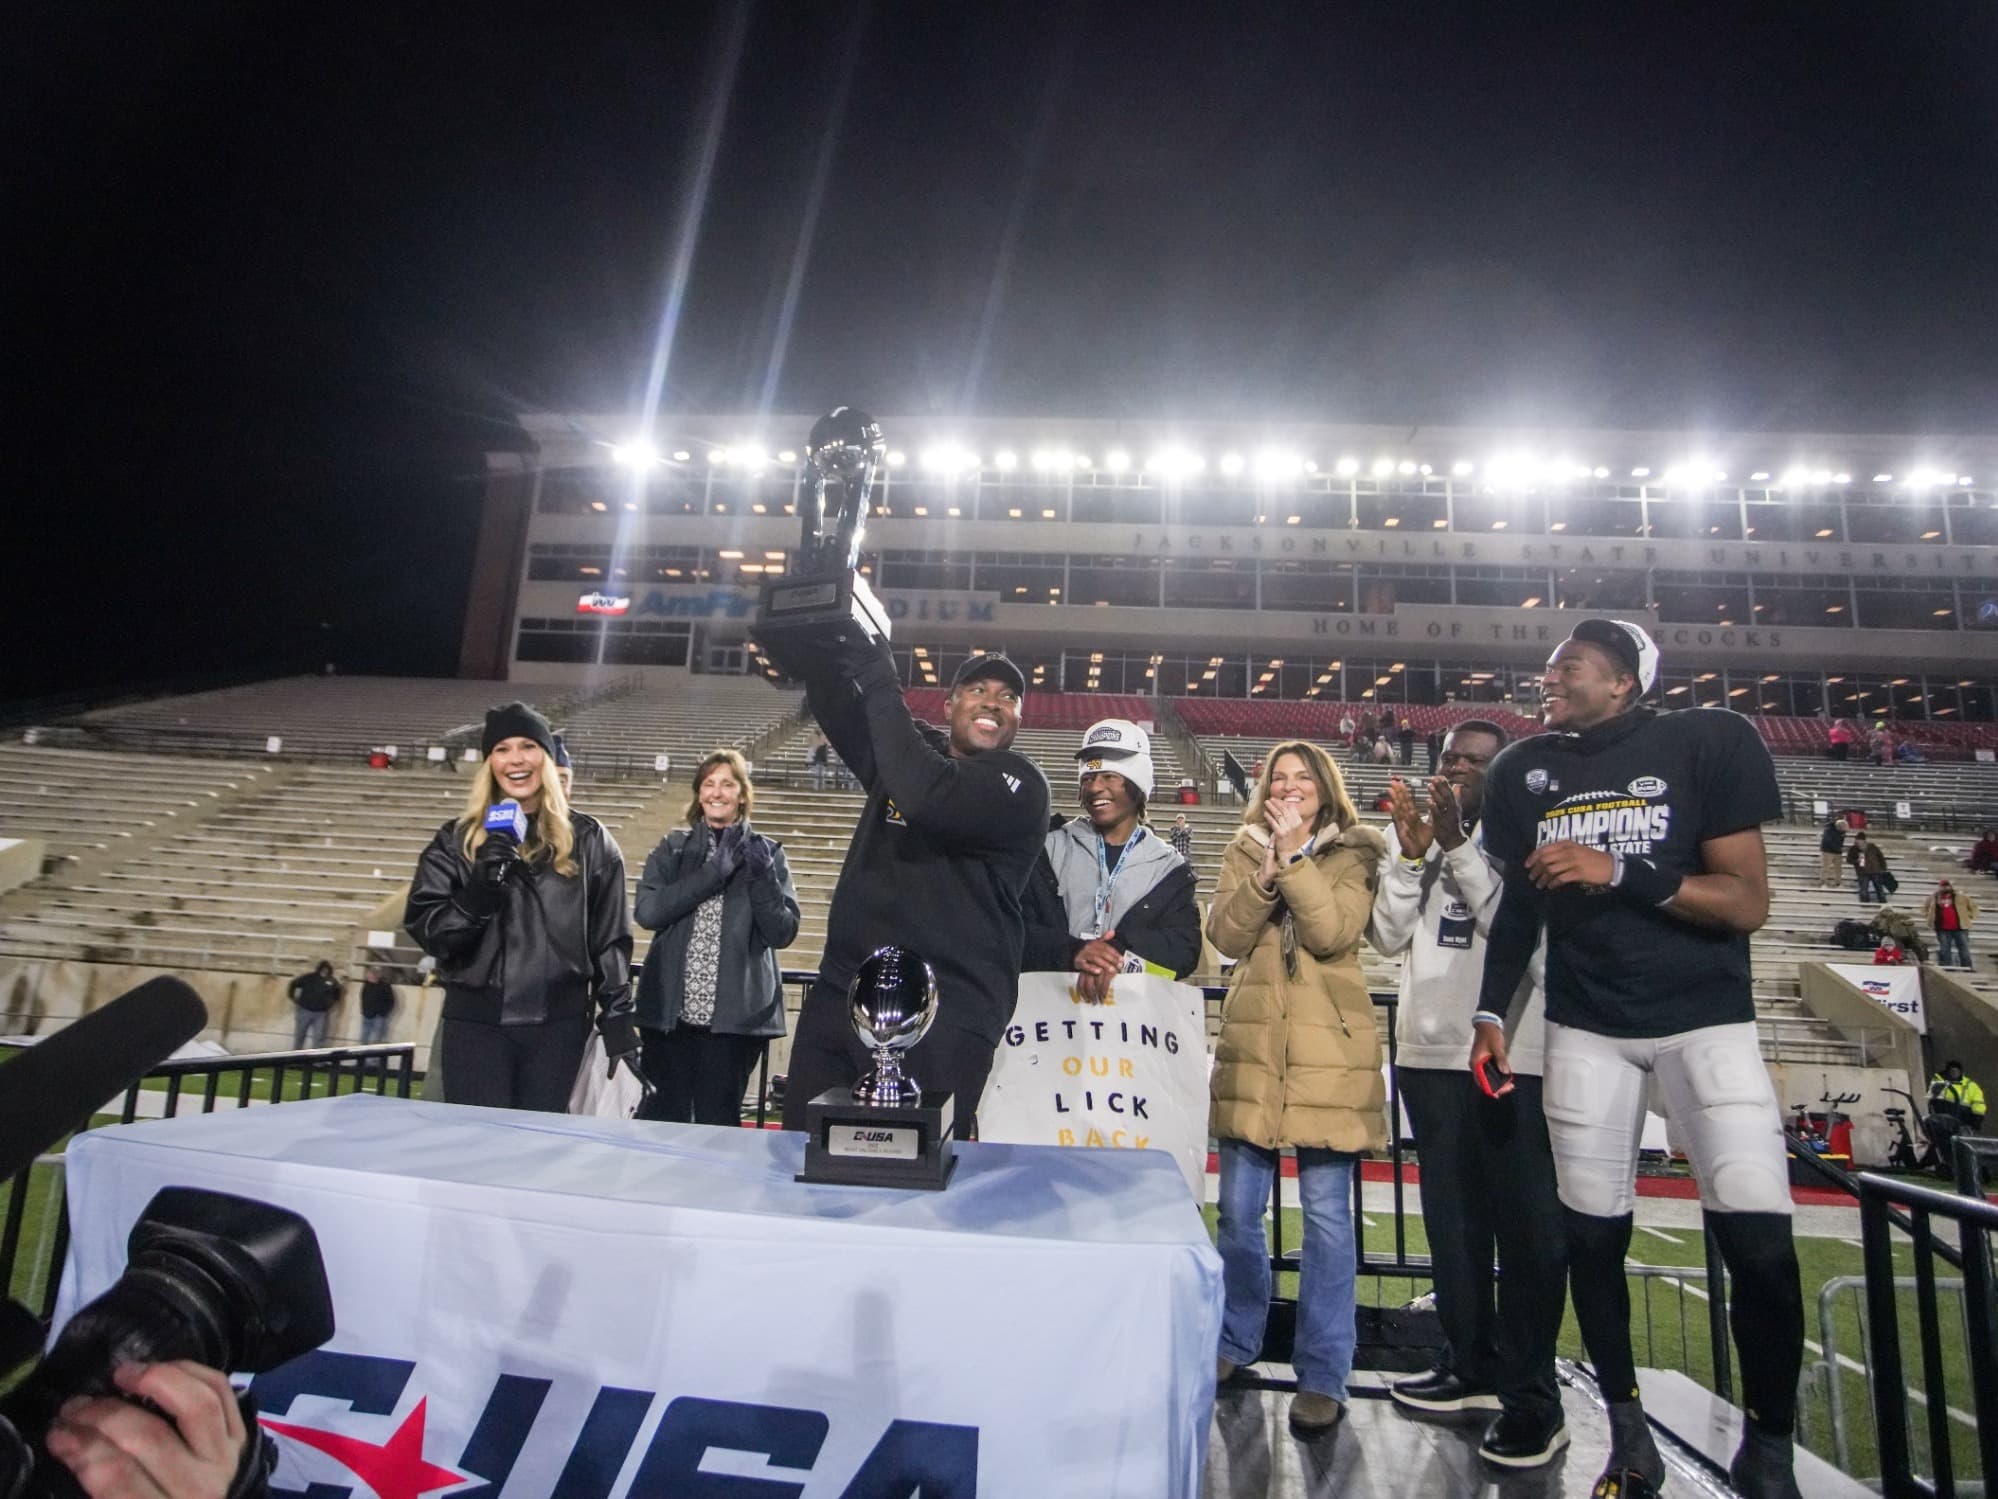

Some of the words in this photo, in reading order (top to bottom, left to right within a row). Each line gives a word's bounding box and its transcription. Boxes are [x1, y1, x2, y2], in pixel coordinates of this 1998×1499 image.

[1133, 533, 1476, 558] JACKSONVILLE
[1522, 539, 1657, 564] STATE
[1711, 547, 1998, 571] UNIVERSIT
[889, 599, 994, 621] DIUM
[1313, 618, 1400, 638] HOME
[1427, 621, 1463, 638] OF
[1490, 624, 1550, 642] THE
[1655, 628, 1782, 649] ECOCKS
[1595, 799, 1647, 810] FOOTBALL
[1536, 805, 1669, 849] CHAMPIONS
[1609, 841, 1651, 855] STATE
[1005, 1021, 1179, 1054] GETTING
[1061, 1056, 1135, 1079] OUR
[1055, 1090, 1149, 1120] LICK
[1058, 1128, 1149, 1149] BACK
